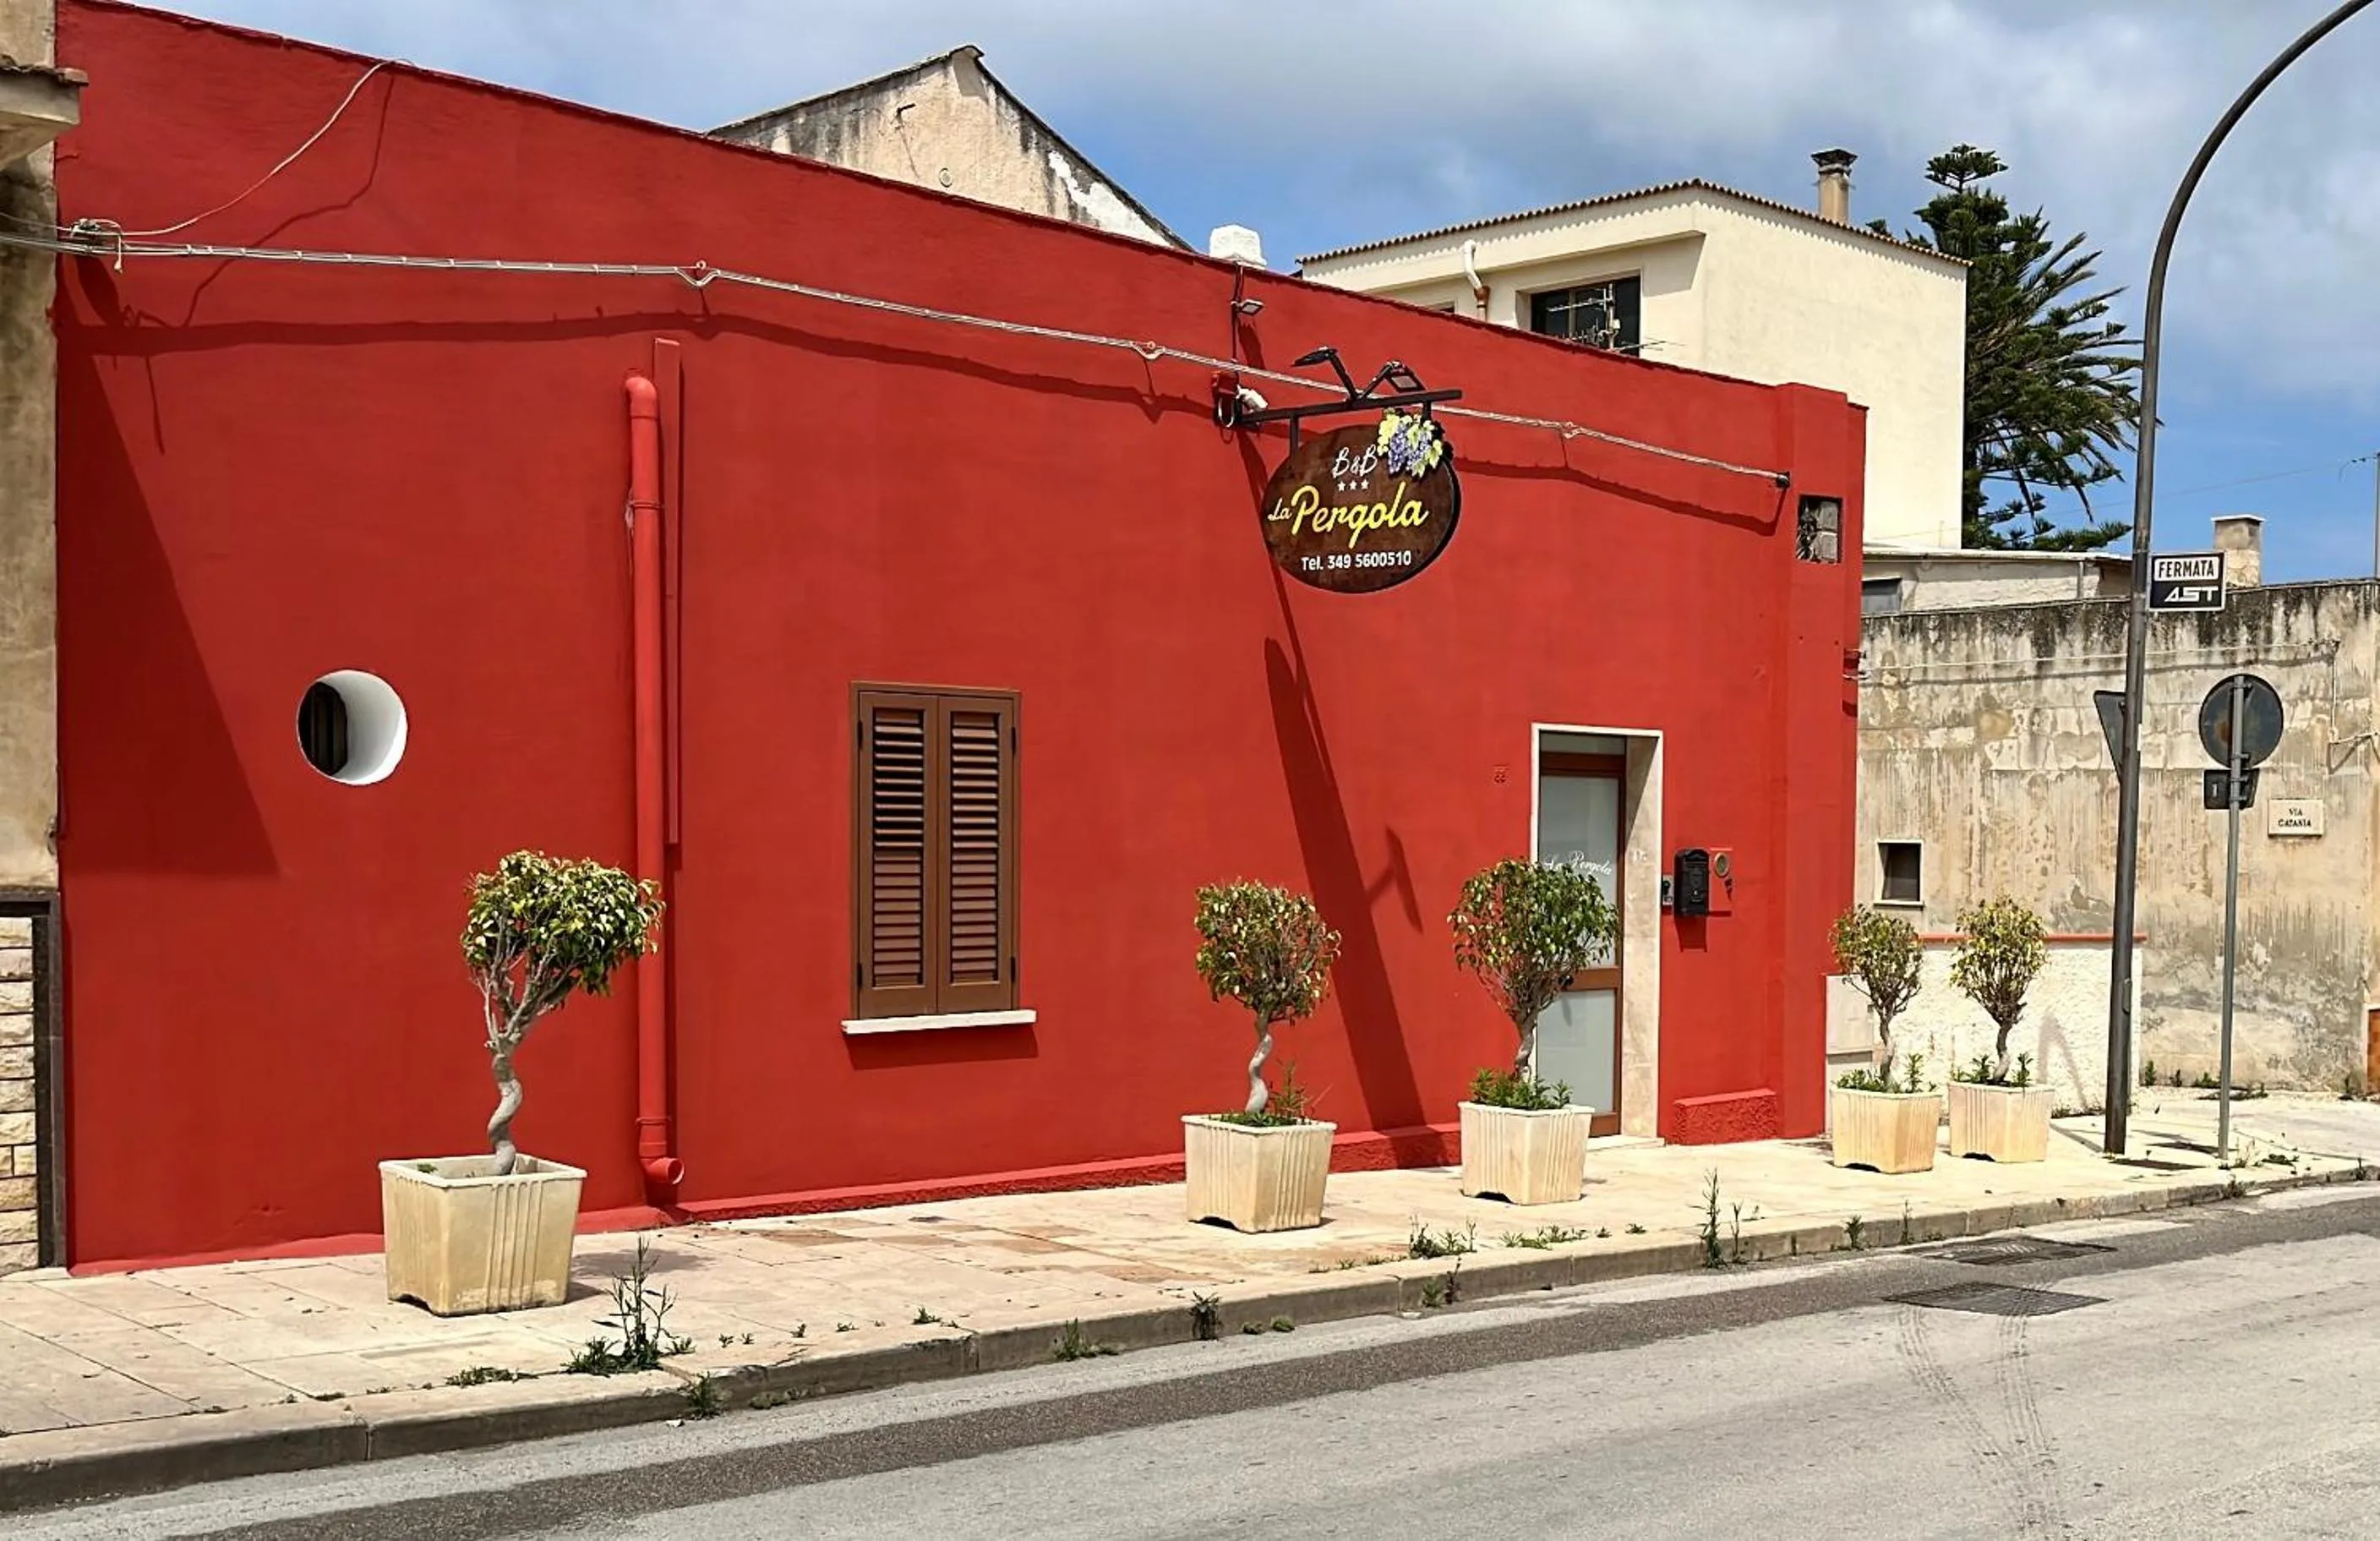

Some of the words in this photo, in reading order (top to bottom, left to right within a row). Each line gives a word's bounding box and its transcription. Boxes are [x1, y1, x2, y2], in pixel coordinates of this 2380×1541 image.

[1332, 444, 1378, 478] B&B
[1268, 498, 1292, 521] La
[1291, 481, 1429, 549] Pergola
[1301, 555, 1324, 571] Tel.
[1328, 554, 1351, 569] 349
[1355, 550, 1411, 568] 5600510
[2159, 560, 2214, 578] FERMATA
[2164, 587, 2219, 602] AST
[2278, 818, 2312, 827] CATANIA
